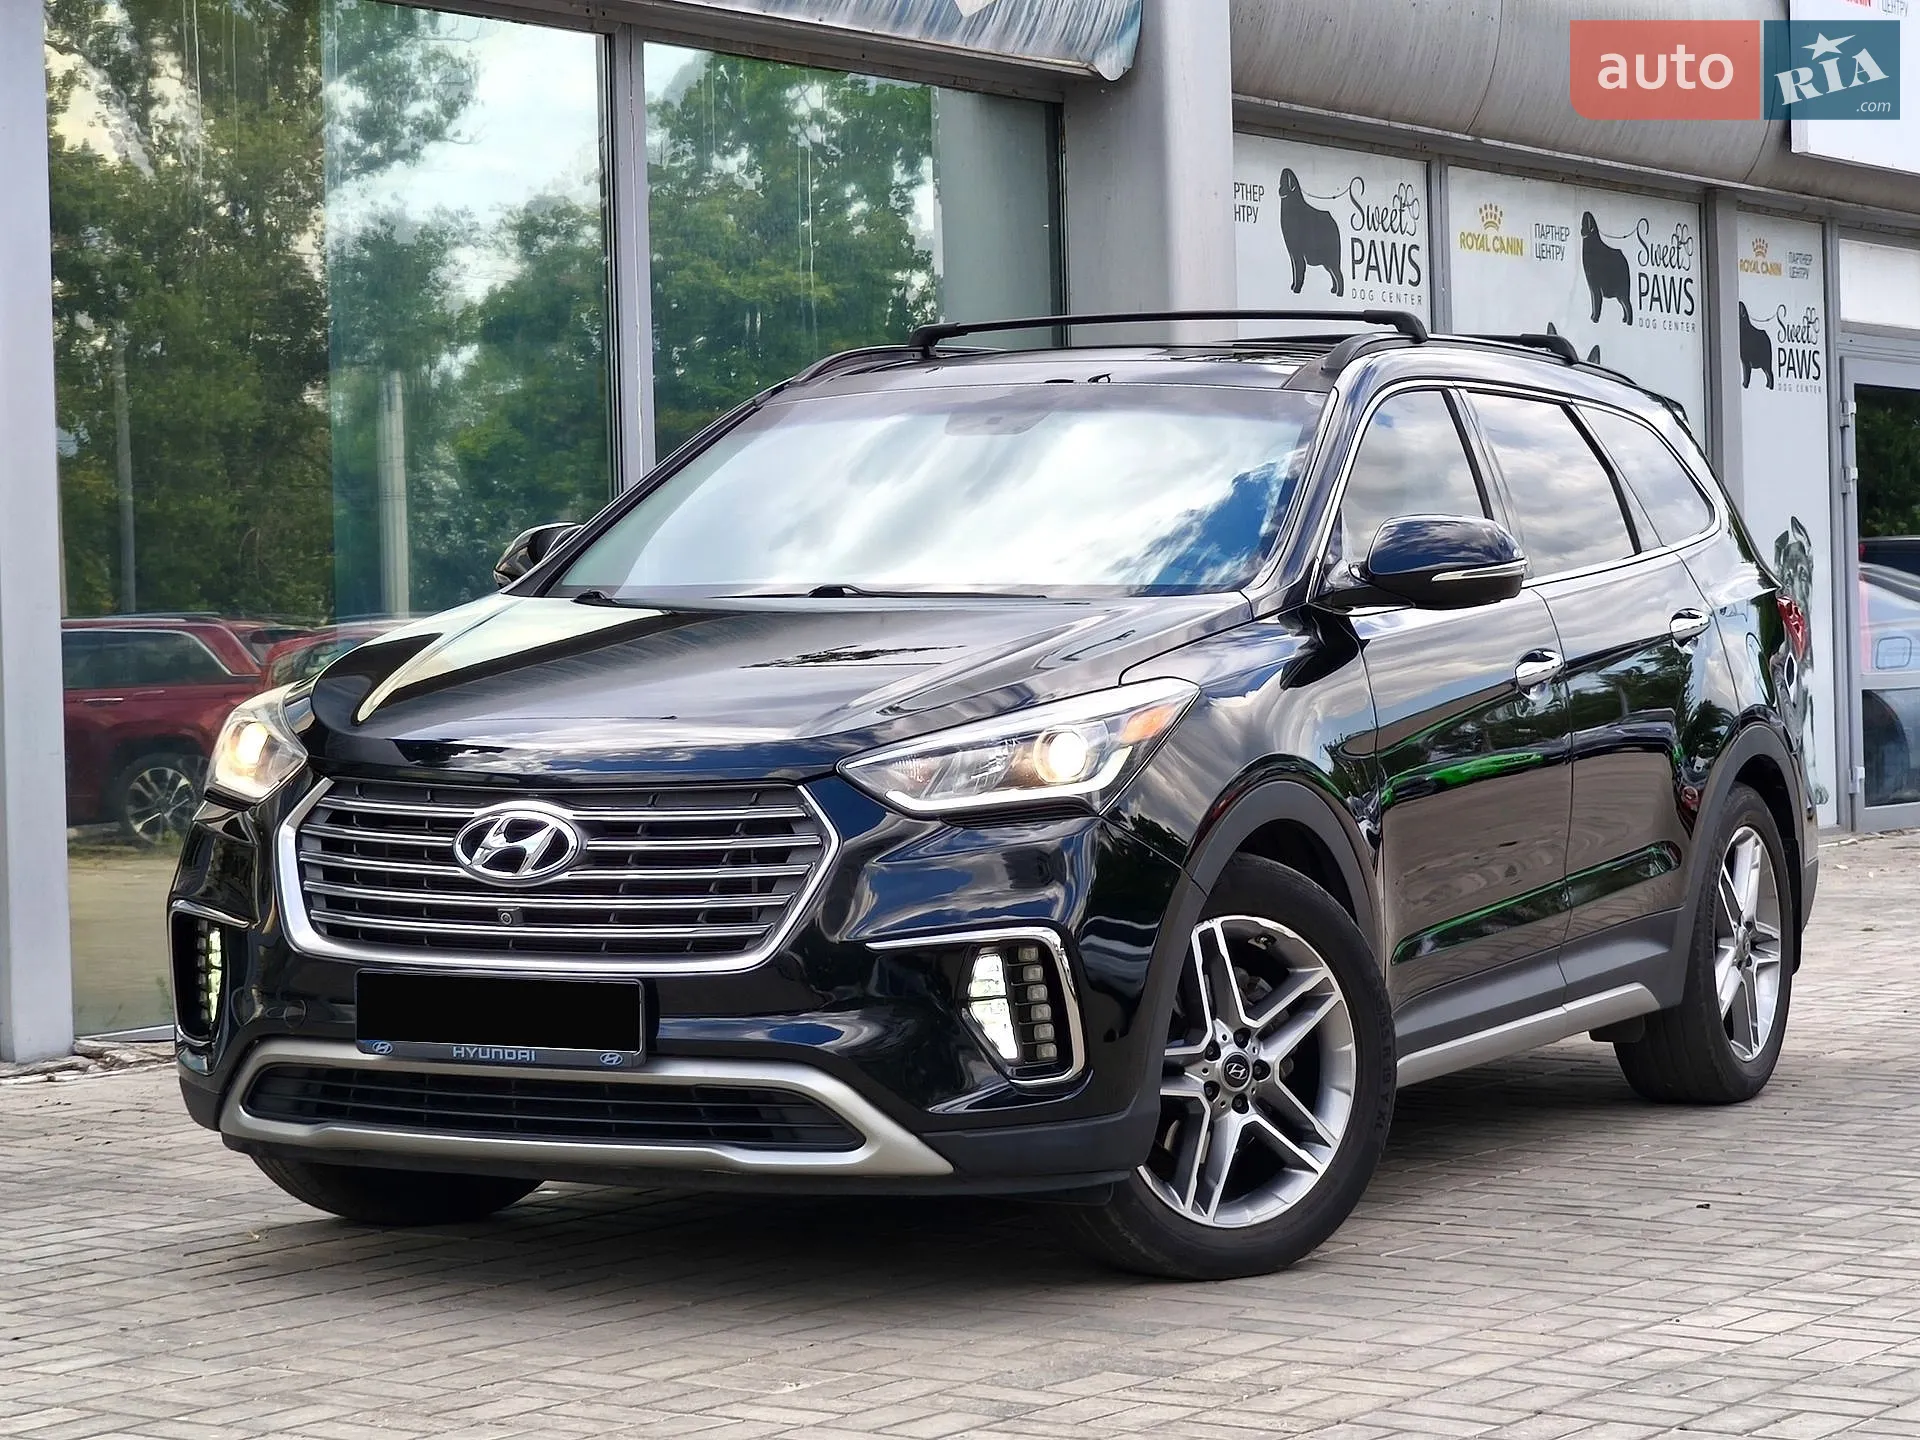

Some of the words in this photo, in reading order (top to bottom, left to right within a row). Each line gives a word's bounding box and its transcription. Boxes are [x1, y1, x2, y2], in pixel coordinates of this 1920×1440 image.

[1233, 181, 1265, 202] РТНЕР
[1234, 203, 1259, 224] НТРУ
[1350, 176, 1413, 236] Sweet
[1460, 231, 1491, 252] ROYAL
[1492, 235, 1524, 256] CANIN
[1534, 223, 1570, 242] ПАРТНЕР
[1637, 218, 1686, 270] Sweet
[1350, 237, 1422, 287] PAWS
[1535, 243, 1565, 261] ЦЕНТРУ
[1351, 288, 1375, 301] DOG
[1381, 290, 1423, 306] CENTER
[1637, 272, 1695, 316] PAWS
[1638, 317, 1657, 330] DOG
[1662, 319, 1696, 333] CENTER
[1777, 304, 1813, 344] Sweet
[1778, 347, 1821, 381] PAWS
[452, 1046, 536, 1061] HYUNDAI
